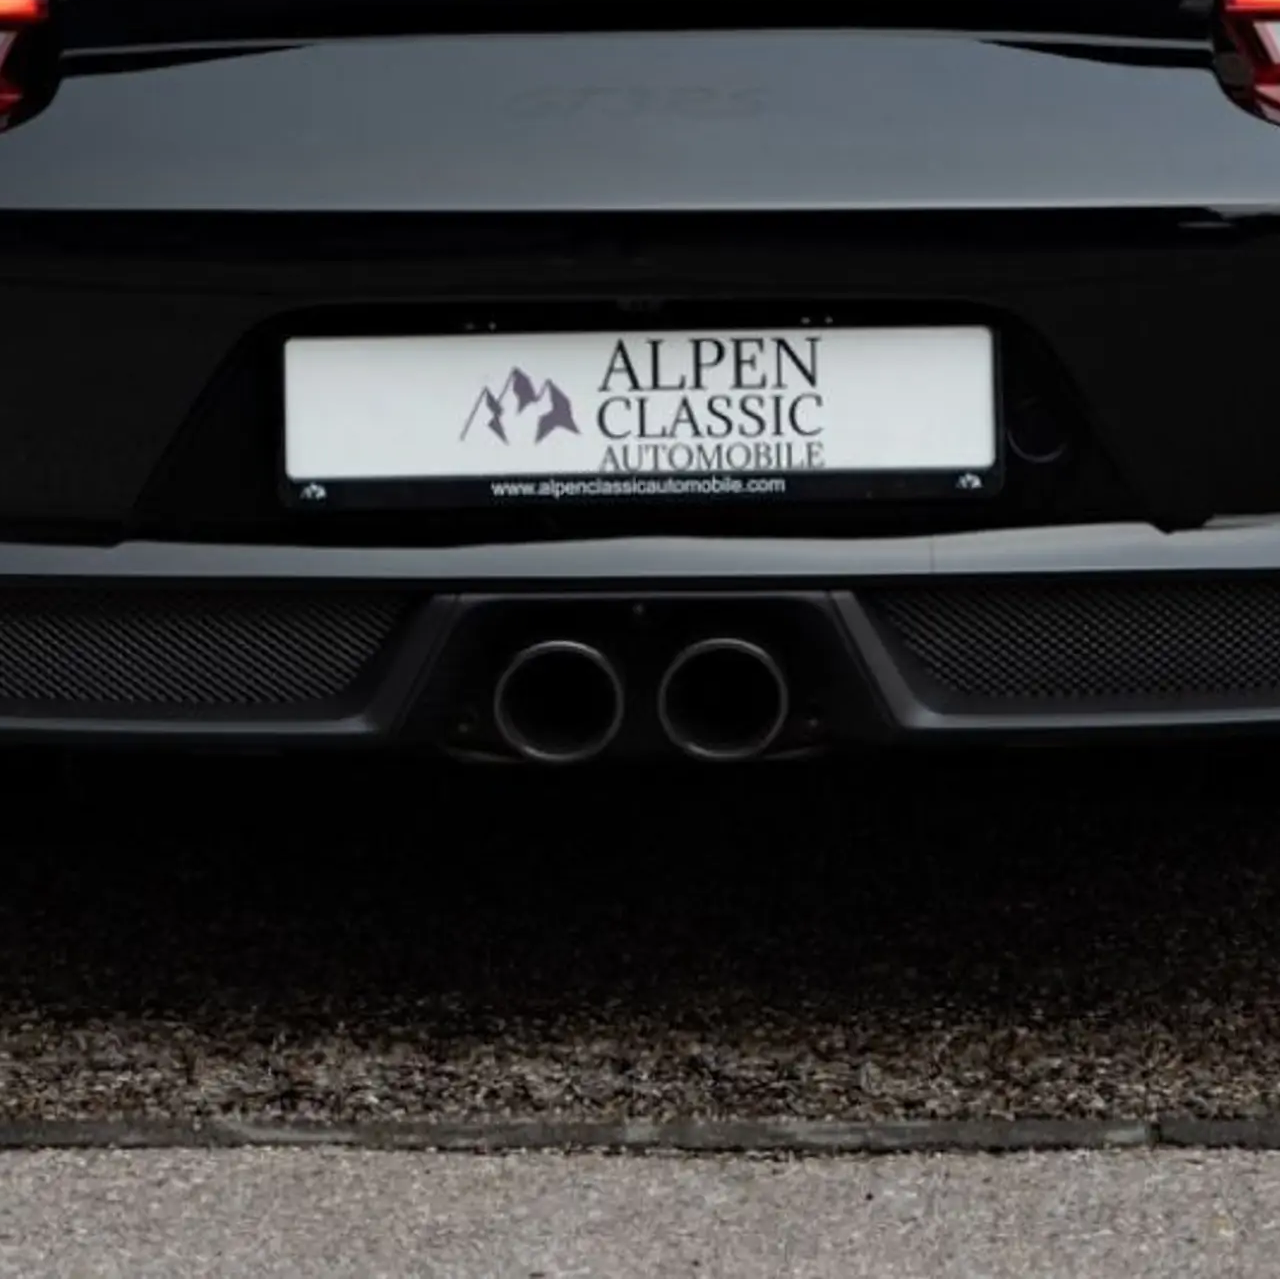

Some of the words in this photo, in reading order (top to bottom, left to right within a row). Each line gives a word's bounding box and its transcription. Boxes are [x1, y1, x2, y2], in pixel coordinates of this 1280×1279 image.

[597, 337, 822, 392] ALPEN
[597, 393, 824, 439] CLASSIC
[599, 441, 826, 472] AUTOMOBILE
[491, 477, 787, 498] www.alpenclassicautomobile.com
